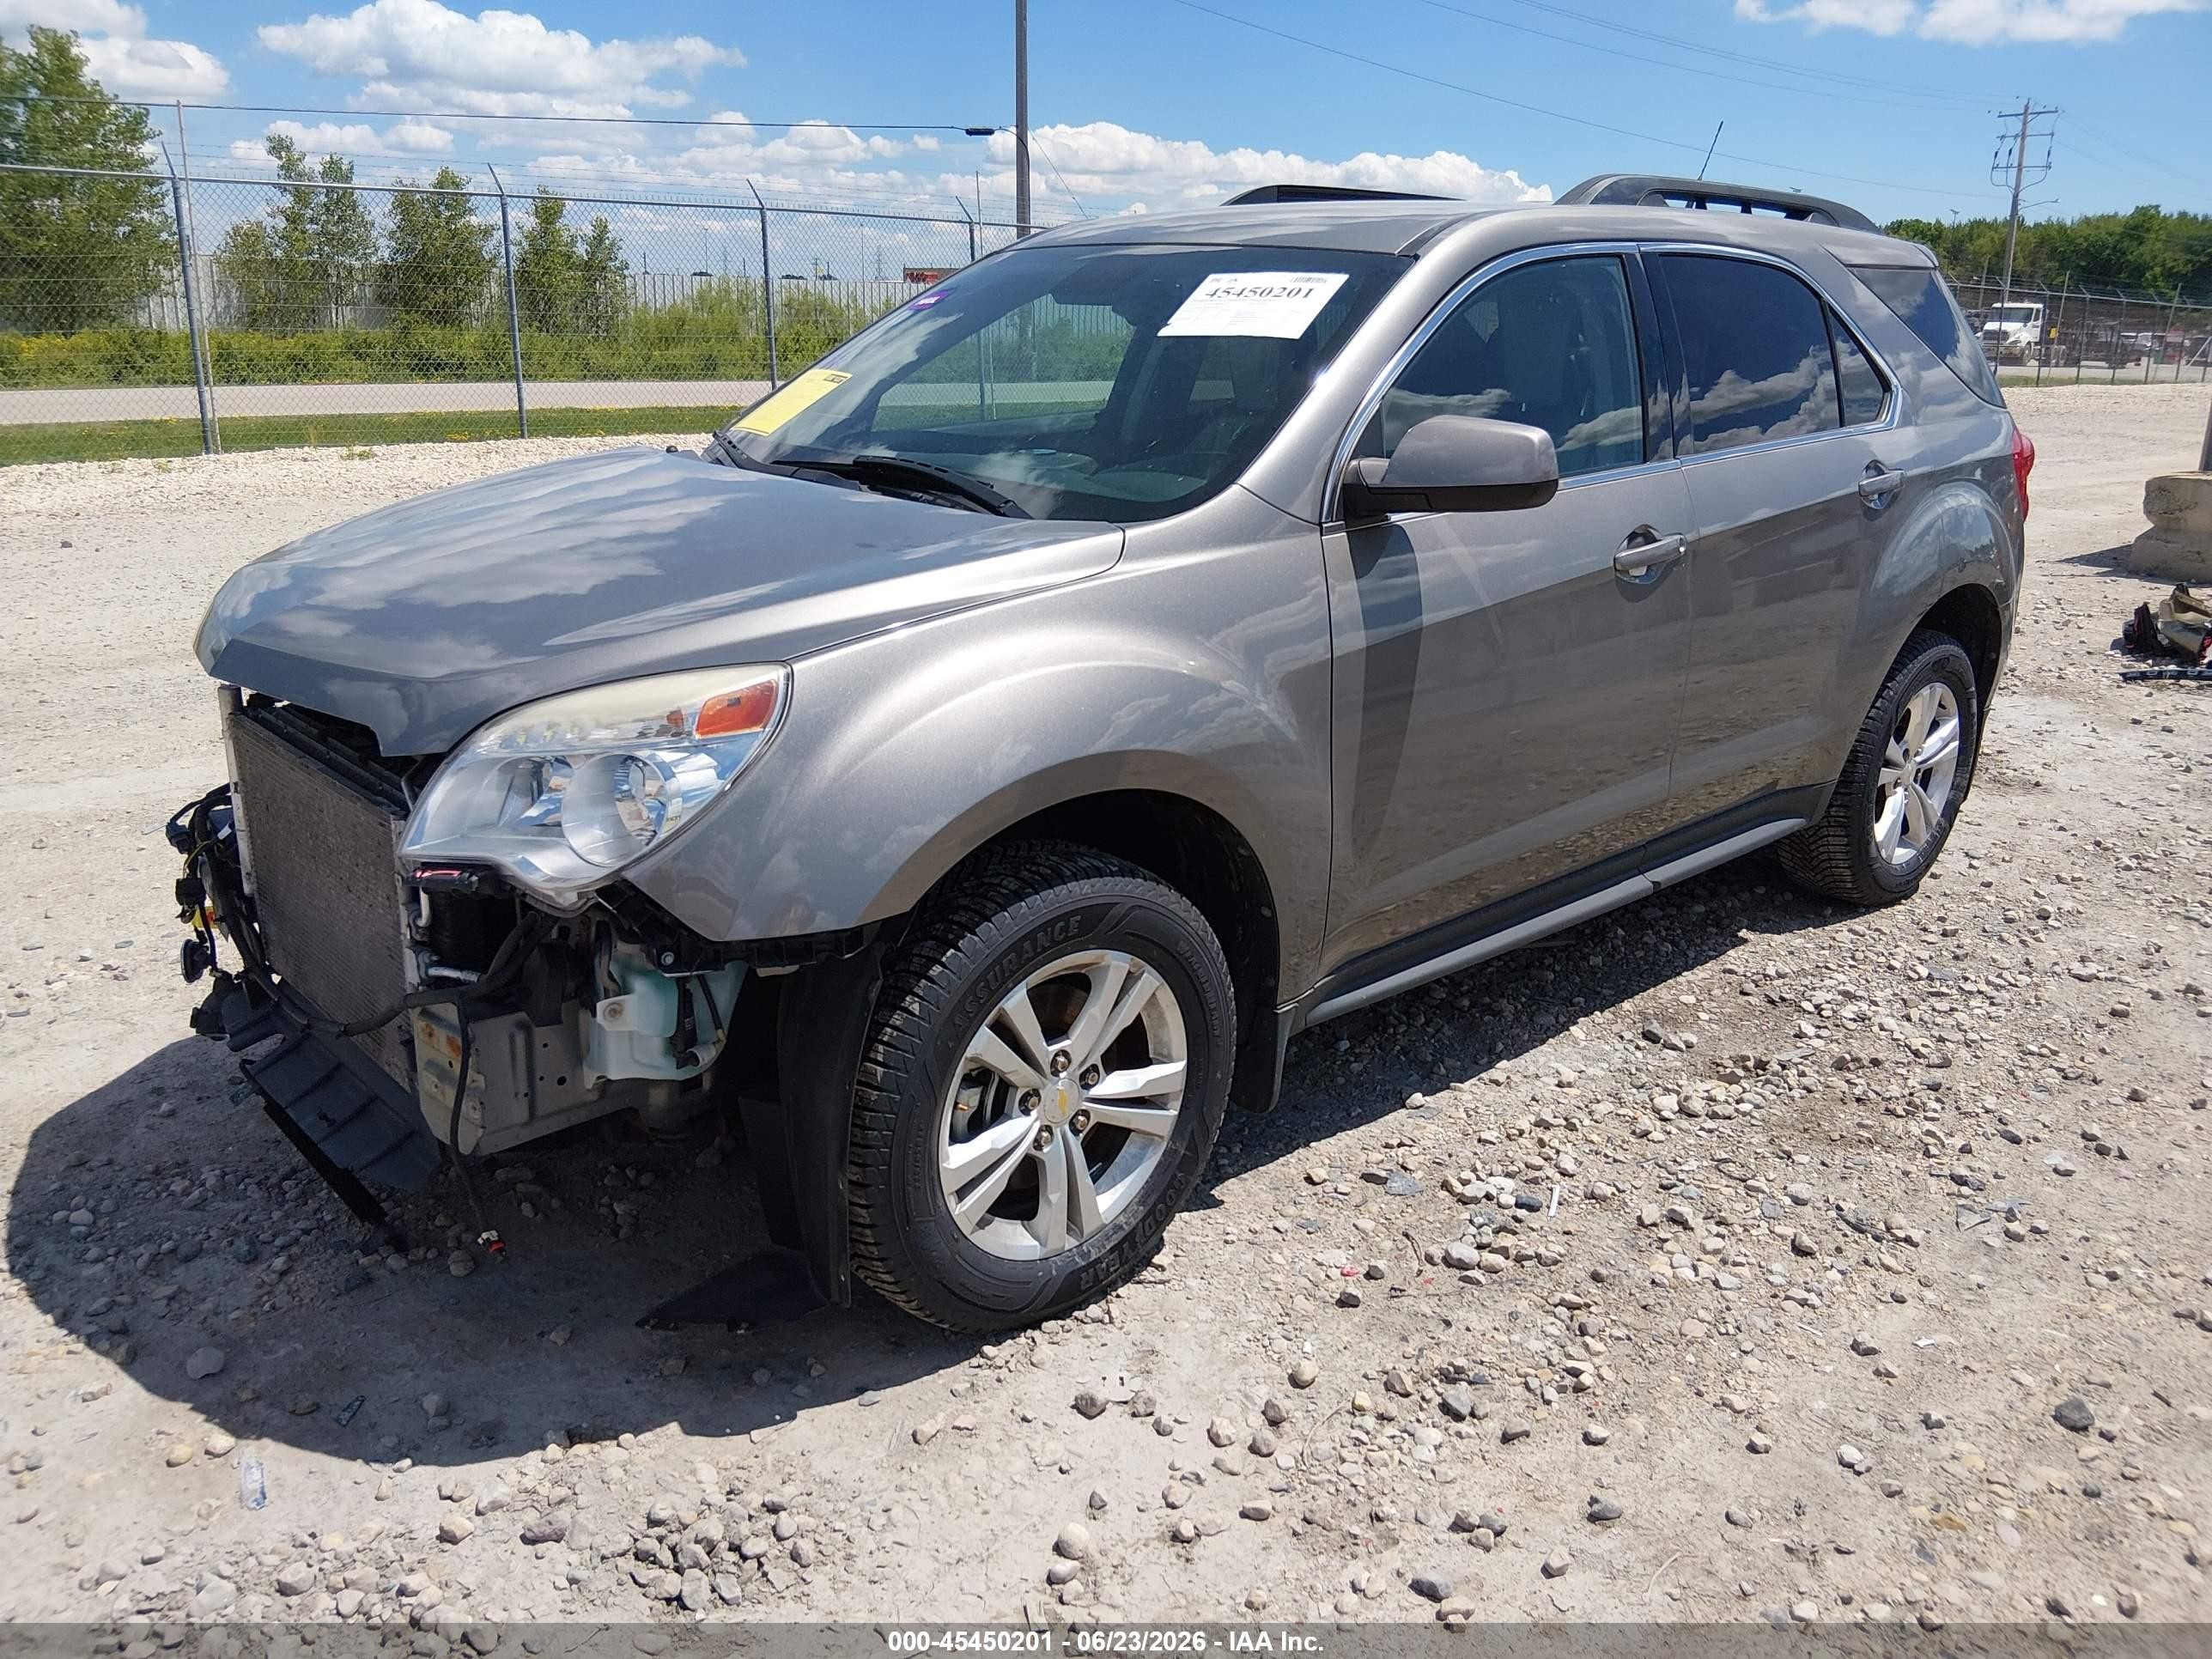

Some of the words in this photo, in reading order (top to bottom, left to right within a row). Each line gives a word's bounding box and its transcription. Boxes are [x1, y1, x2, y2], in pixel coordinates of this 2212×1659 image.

[1205, 286, 1315, 299] 45450201
[953, 915, 1082, 1031] ASSURANCE
[1080, 1173, 1188, 1290] GOODYEAR
